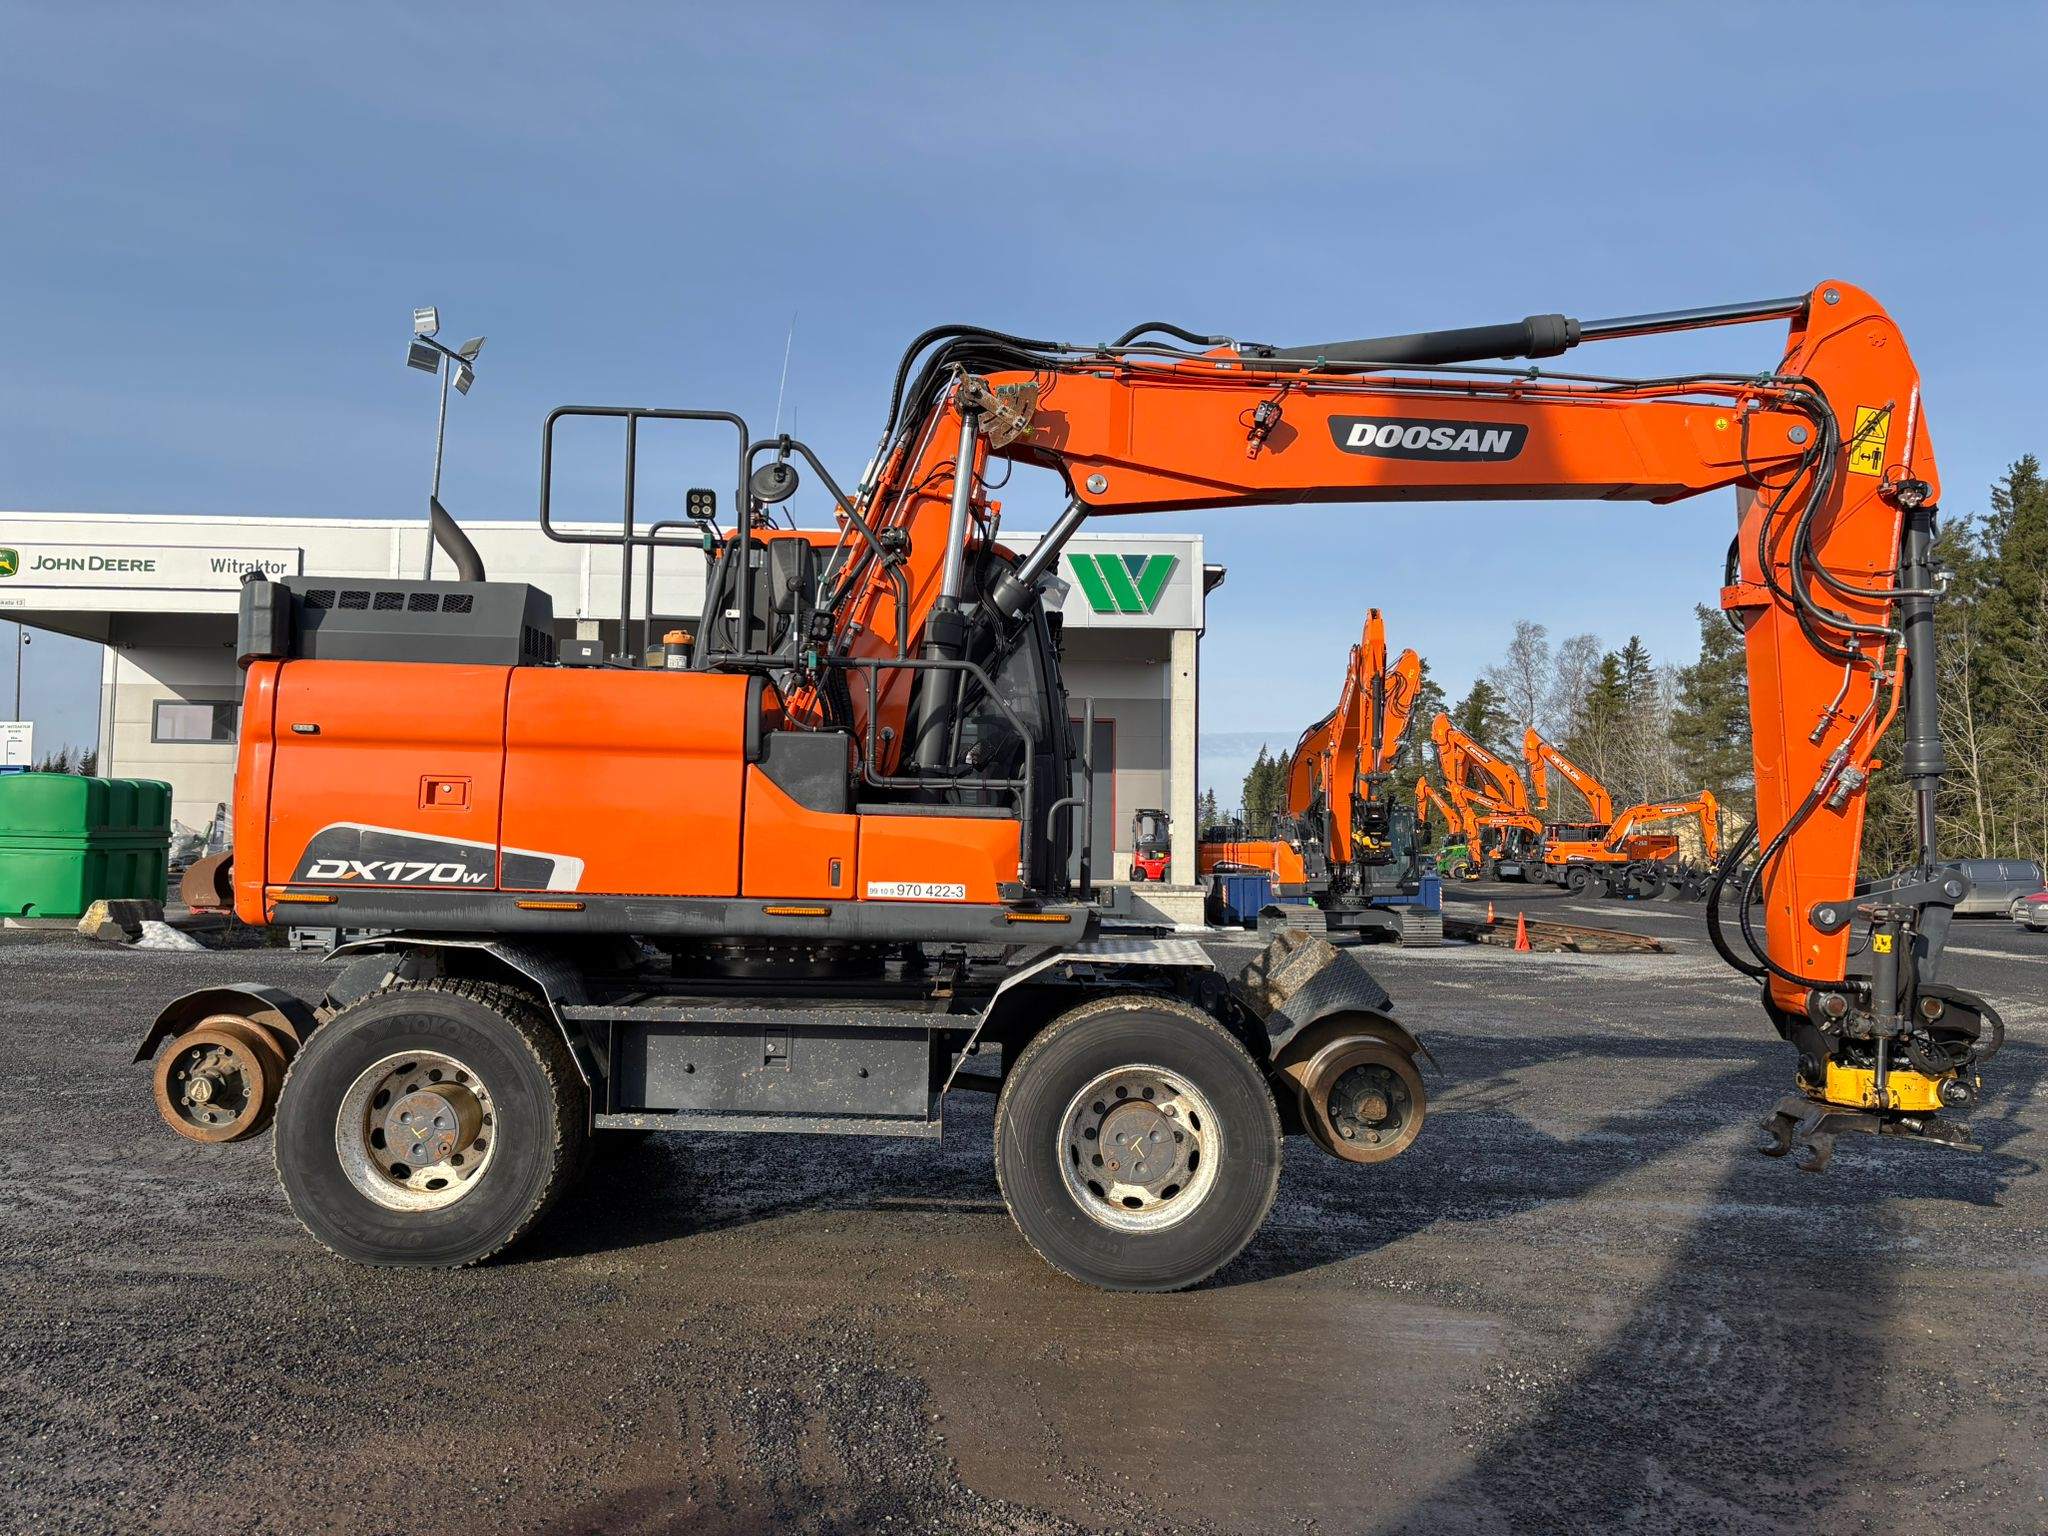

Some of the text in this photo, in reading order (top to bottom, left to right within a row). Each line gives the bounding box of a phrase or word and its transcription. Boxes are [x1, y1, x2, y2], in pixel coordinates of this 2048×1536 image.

[1347, 423, 1513, 453] DOOSAN
[30, 555, 156, 572] JOHN DEERE
[210, 558, 287, 574] Witraktor
[1551, 754, 1580, 781] DEVELON
[897, 884, 922, 897] 970
[925, 885, 964, 898] 422-3
